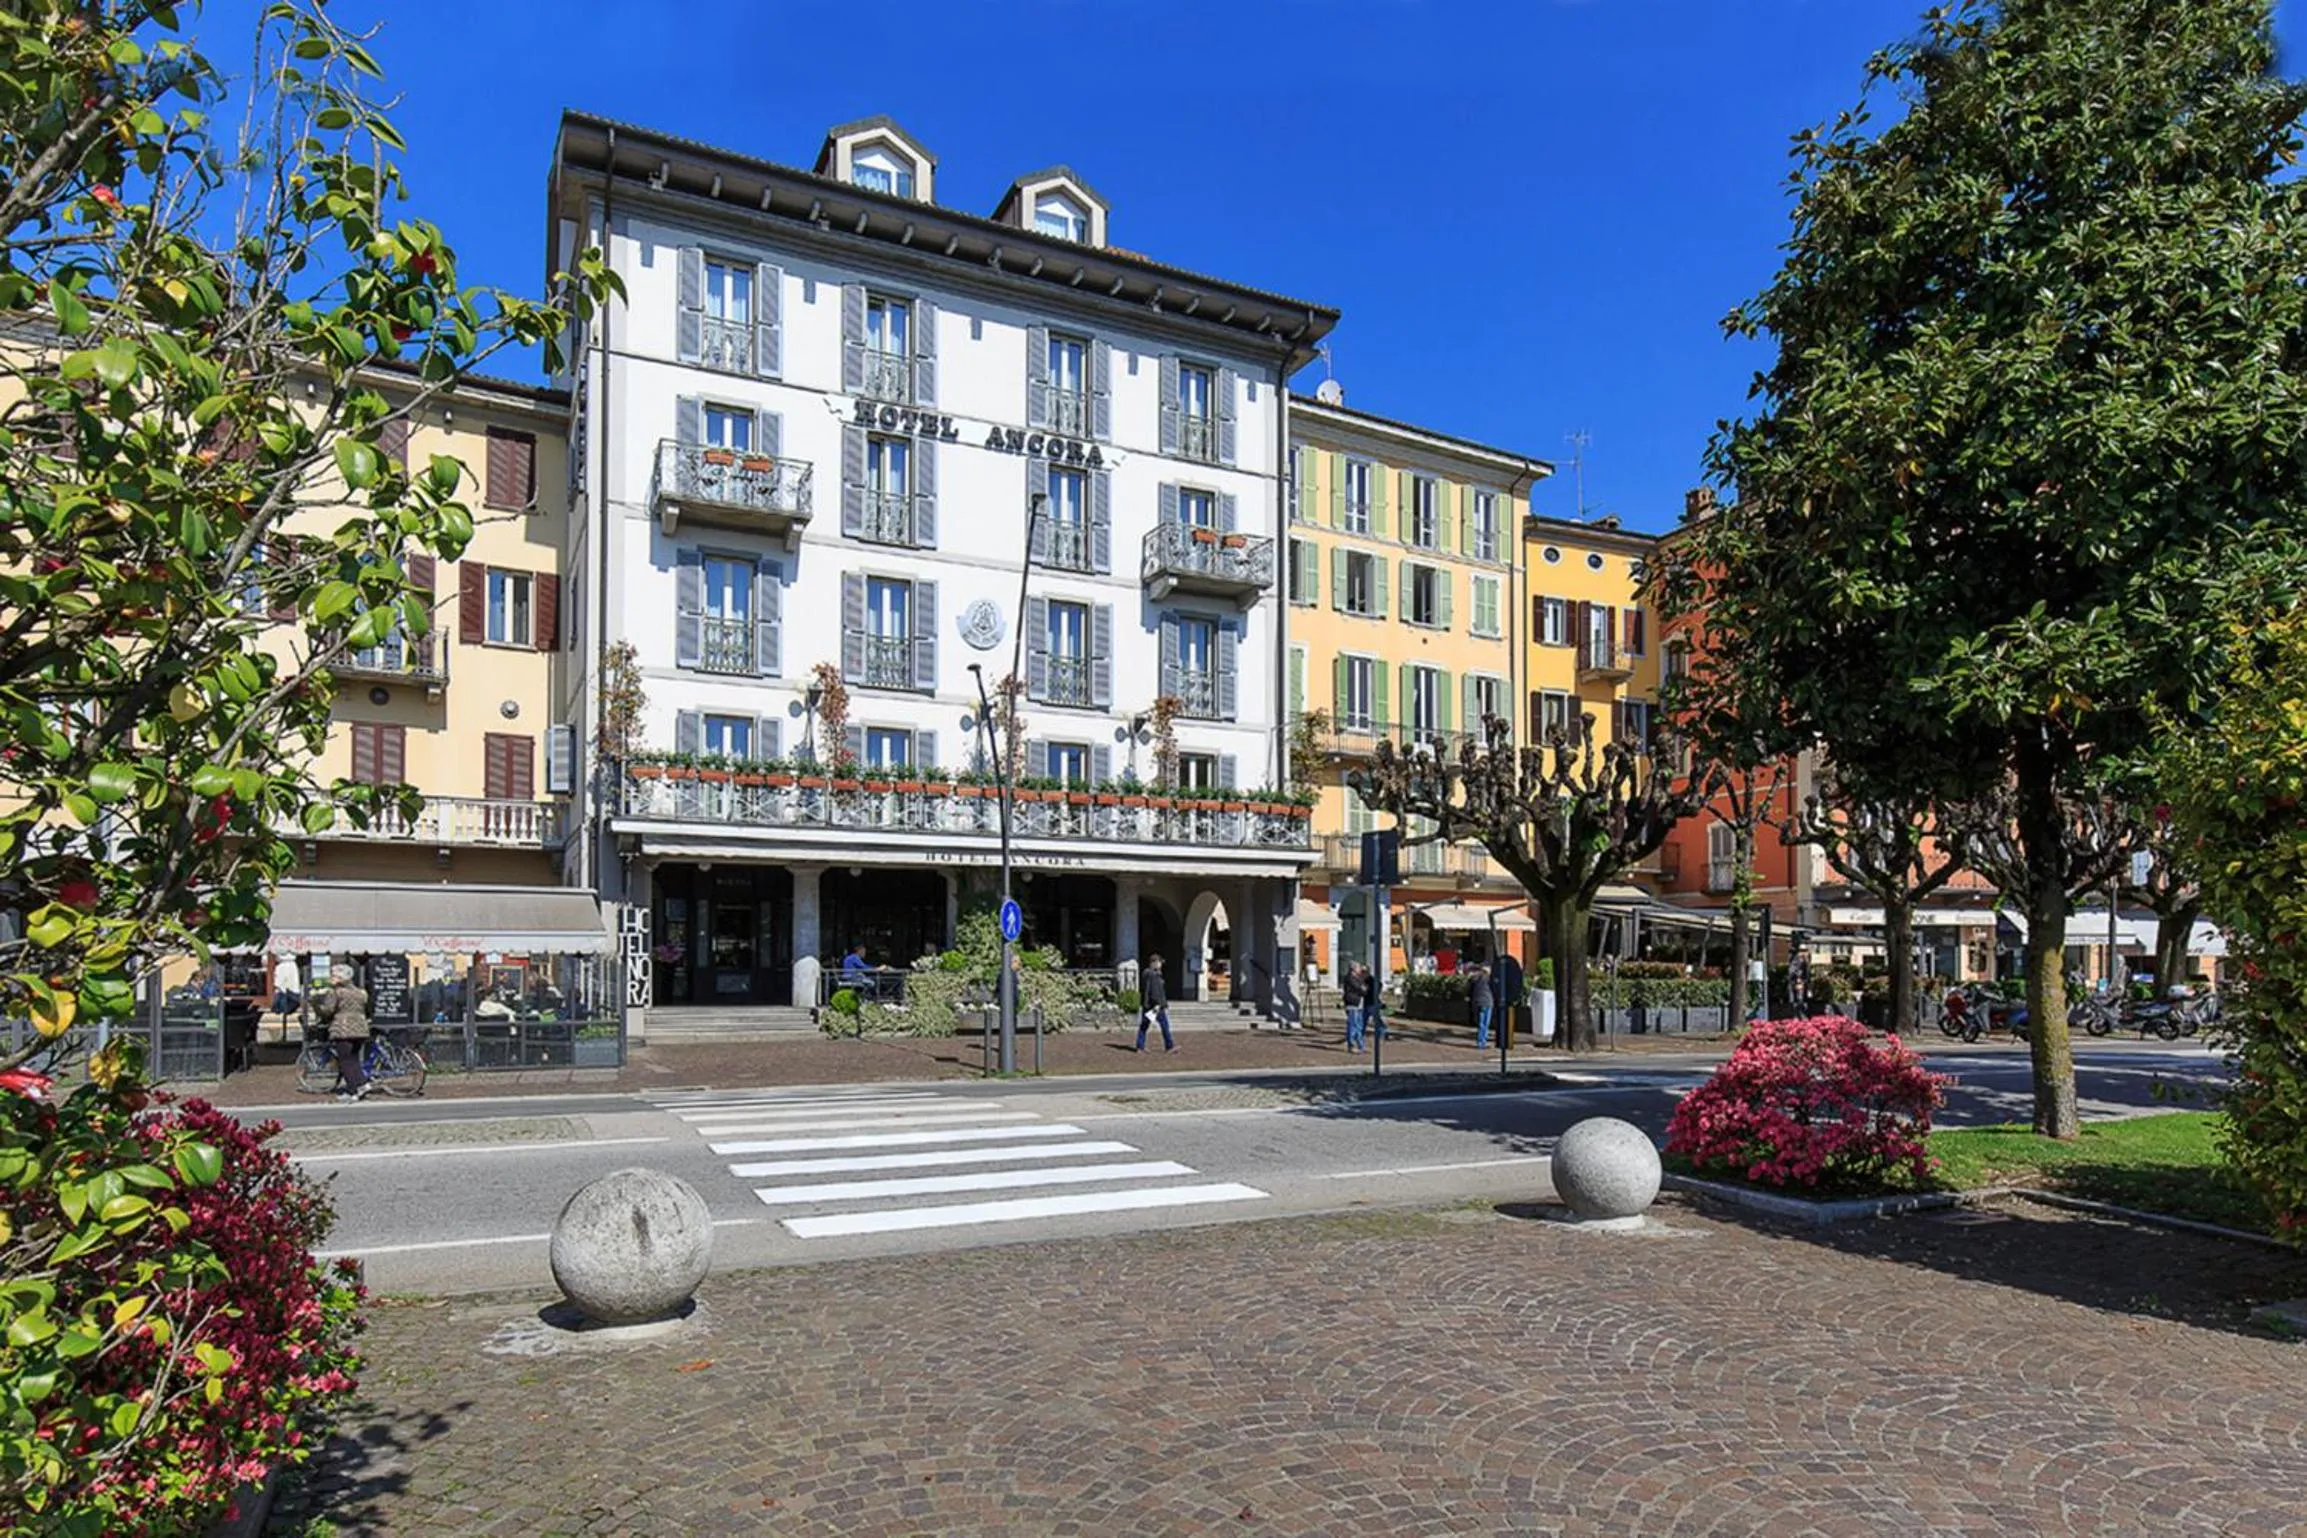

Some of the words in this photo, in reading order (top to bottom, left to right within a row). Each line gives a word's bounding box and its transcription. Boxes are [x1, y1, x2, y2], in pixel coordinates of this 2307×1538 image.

[854, 401, 959, 443] HOTEL
[984, 426, 1106, 467] ANCORA
[926, 852, 991, 864] HOTEL
[1009, 854, 1085, 866] ANCORA
